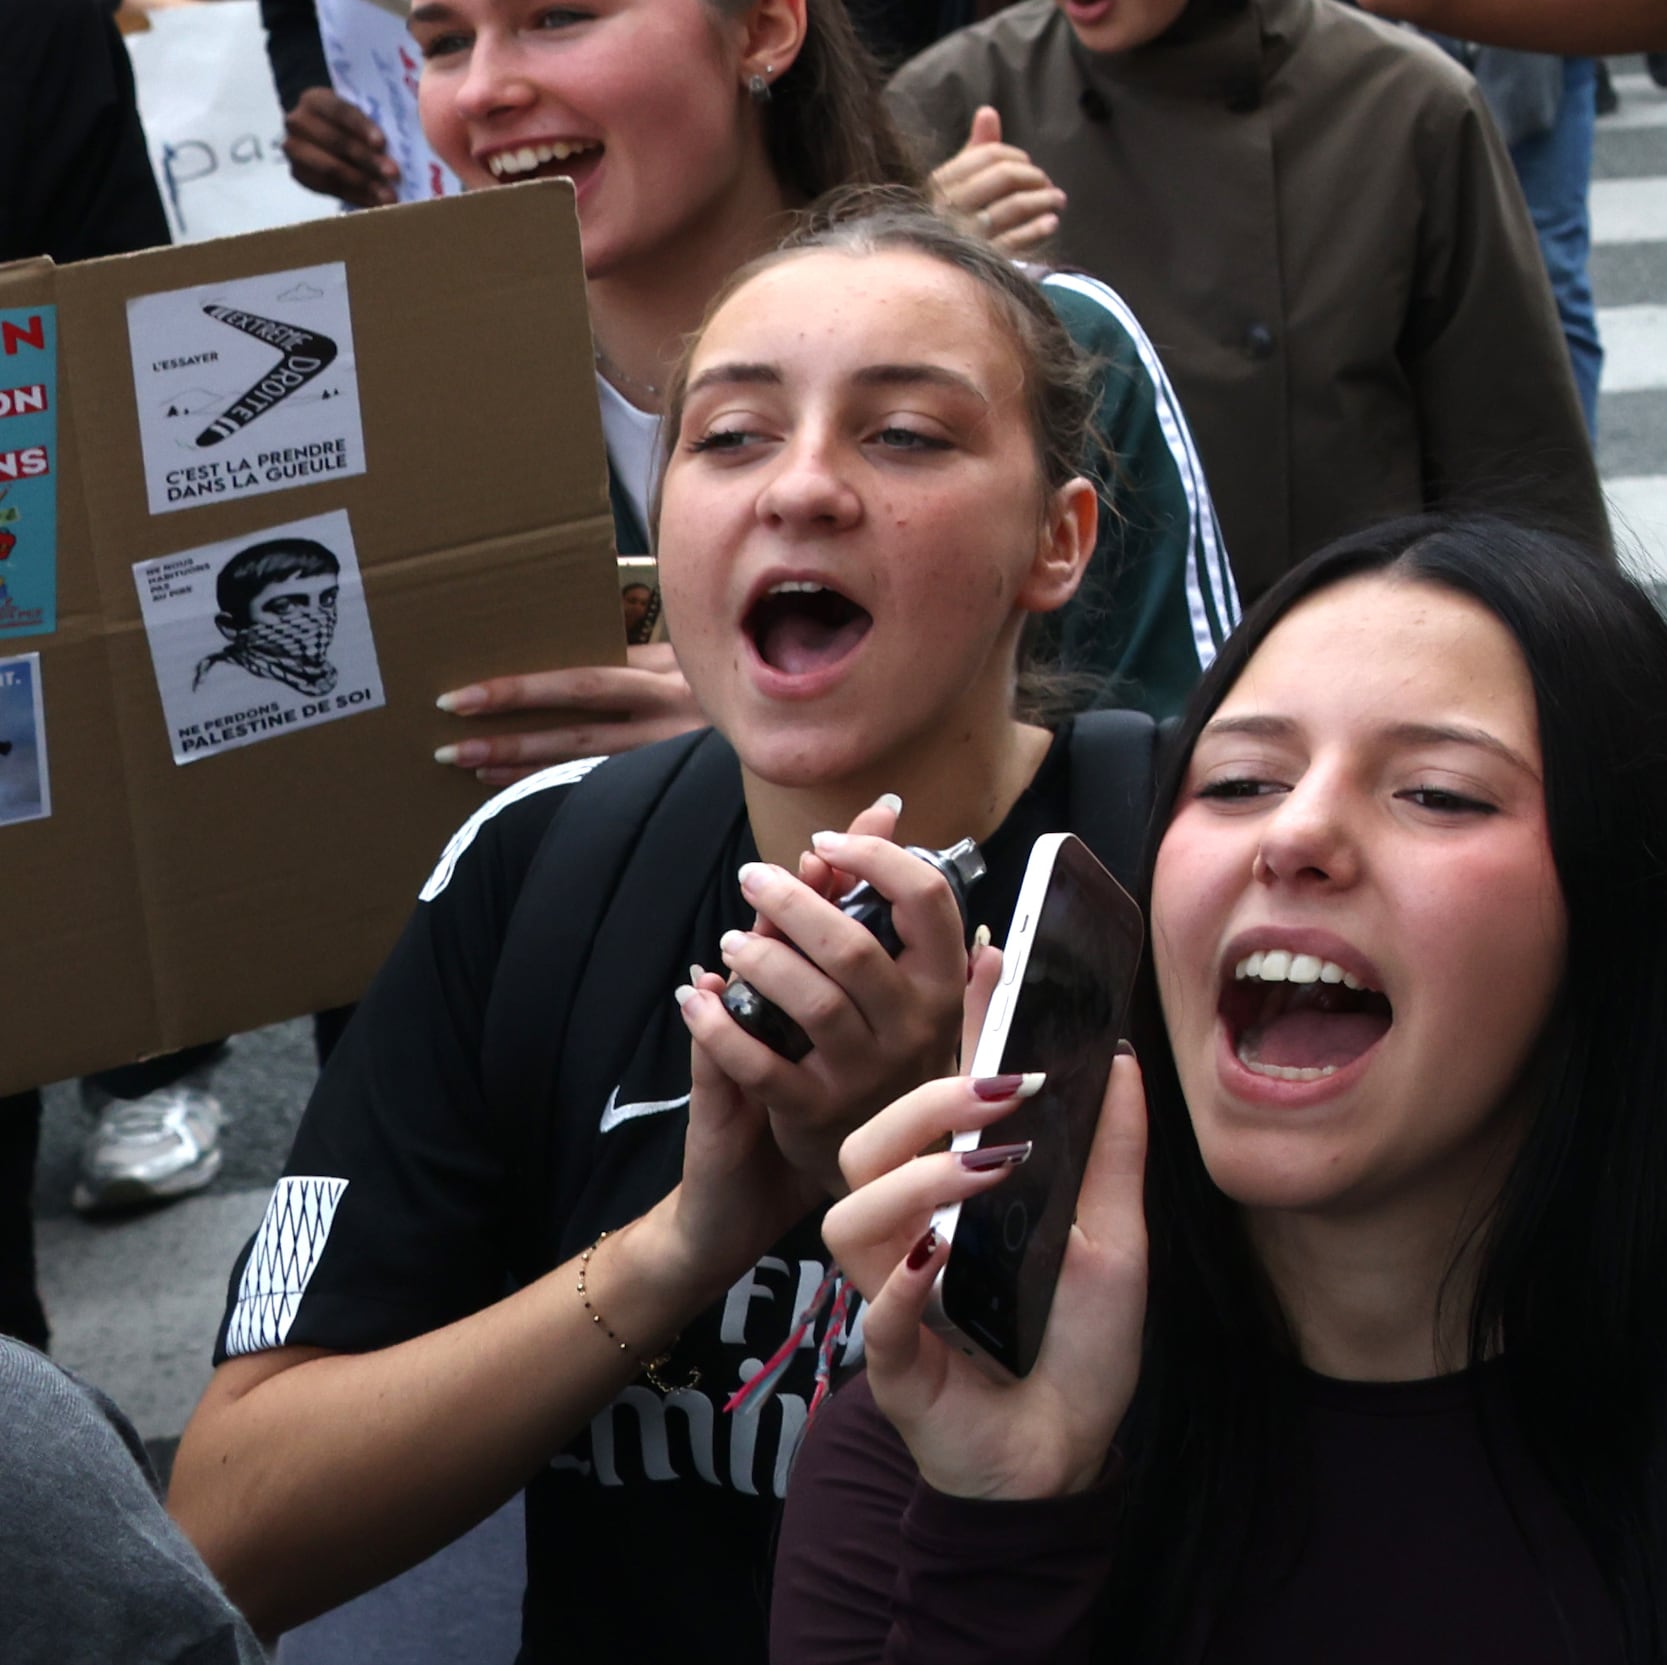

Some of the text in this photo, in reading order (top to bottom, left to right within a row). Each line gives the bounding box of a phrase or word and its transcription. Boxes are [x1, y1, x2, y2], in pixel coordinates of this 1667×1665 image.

[152, 350, 219, 373] L'ESSAYER
[231, 355, 322, 420] DROITE
[165, 438, 347, 486] C'EST LA PRENDRE
[167, 453, 348, 503] DANS LA GUEULE
[178, 702, 280, 739] NE PERDONS
[181, 688, 372, 754] PALESTINE DE SOI
